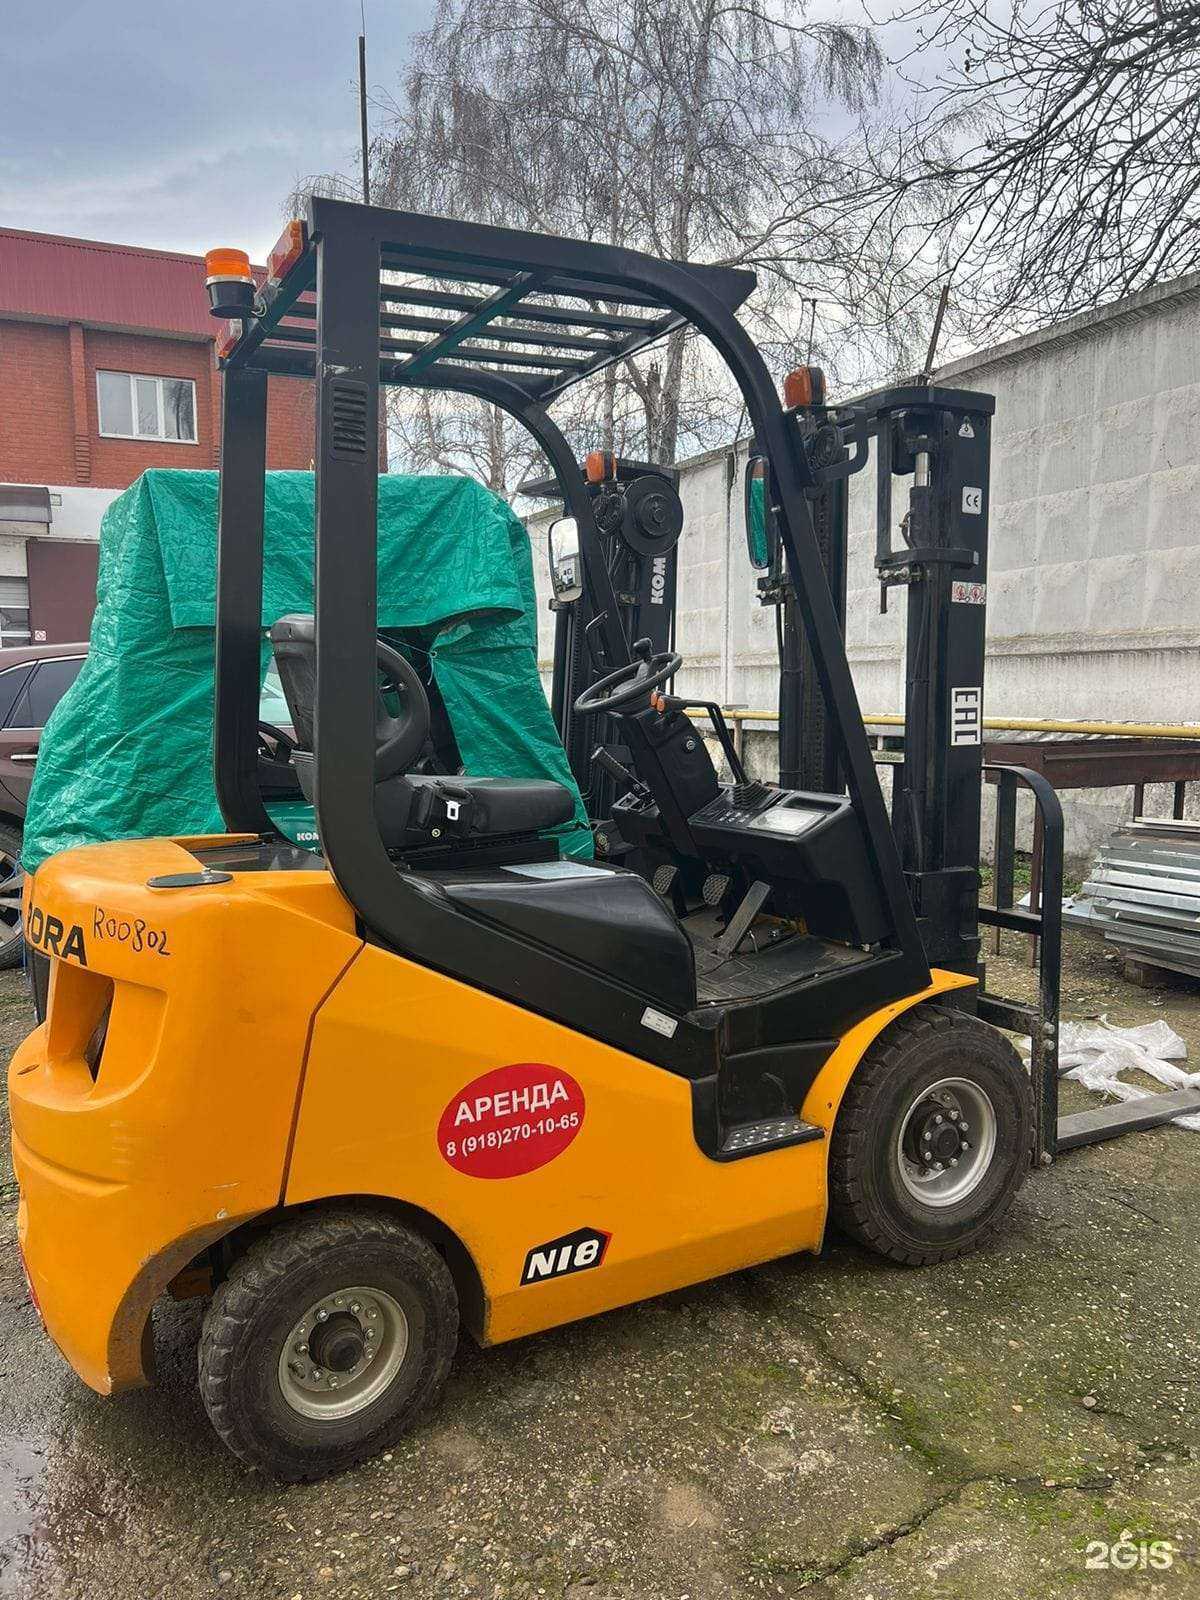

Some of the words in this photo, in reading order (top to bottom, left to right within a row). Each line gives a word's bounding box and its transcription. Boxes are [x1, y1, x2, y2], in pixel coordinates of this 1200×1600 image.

[651, 557, 666, 605] KOM
[28, 901, 88, 967] ORA
[454, 1079, 570, 1127] АРЕНДА
[446, 1141, 457, 1157] 8
[461, 1112, 580, 1157] (918)270-10-65
